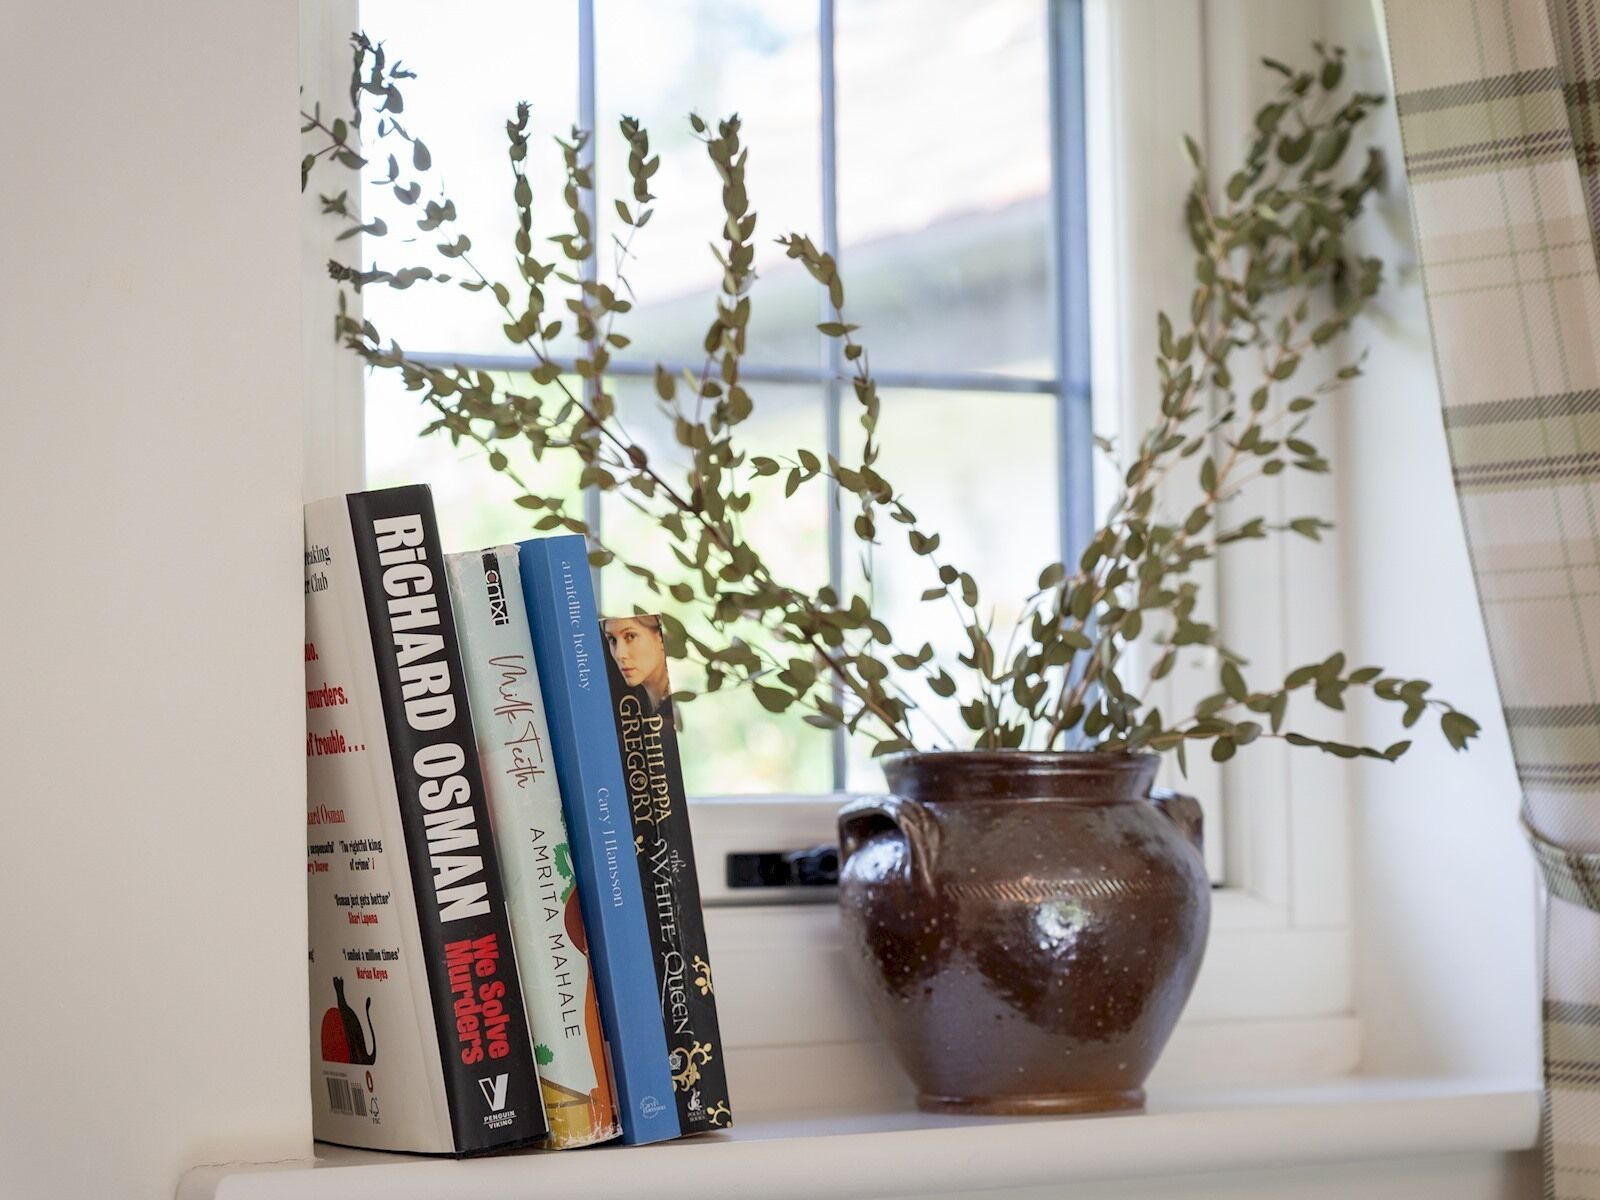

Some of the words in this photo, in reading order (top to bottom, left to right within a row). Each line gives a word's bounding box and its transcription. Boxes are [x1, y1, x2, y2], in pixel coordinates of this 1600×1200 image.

[310, 571, 329, 592] Club
[488, 655, 535, 724] Milk
[572, 633, 591, 692] holiday
[307, 682, 348, 709] murders.
[504, 720, 545, 789] Teeth
[619, 694, 655, 827] GREGORY
[641, 713, 672, 823] PHILIPPA
[320, 803, 346, 824] Osman
[413, 742, 491, 923] OSMAN
[368, 838, 383, 854] king
[597, 787, 612, 825] Cary
[605, 839, 624, 908] Hansson
[471, 933, 500, 978] We
[529, 828, 560, 922] AMRITA
[548, 933, 581, 1039] MAHALE
[372, 967, 389, 982] Keyes
[444, 939, 485, 1065] Murders
[479, 980, 511, 1060] Solve
[483, 1110, 516, 1123] PENGUIN
[488, 1118, 513, 1130] VIKING
